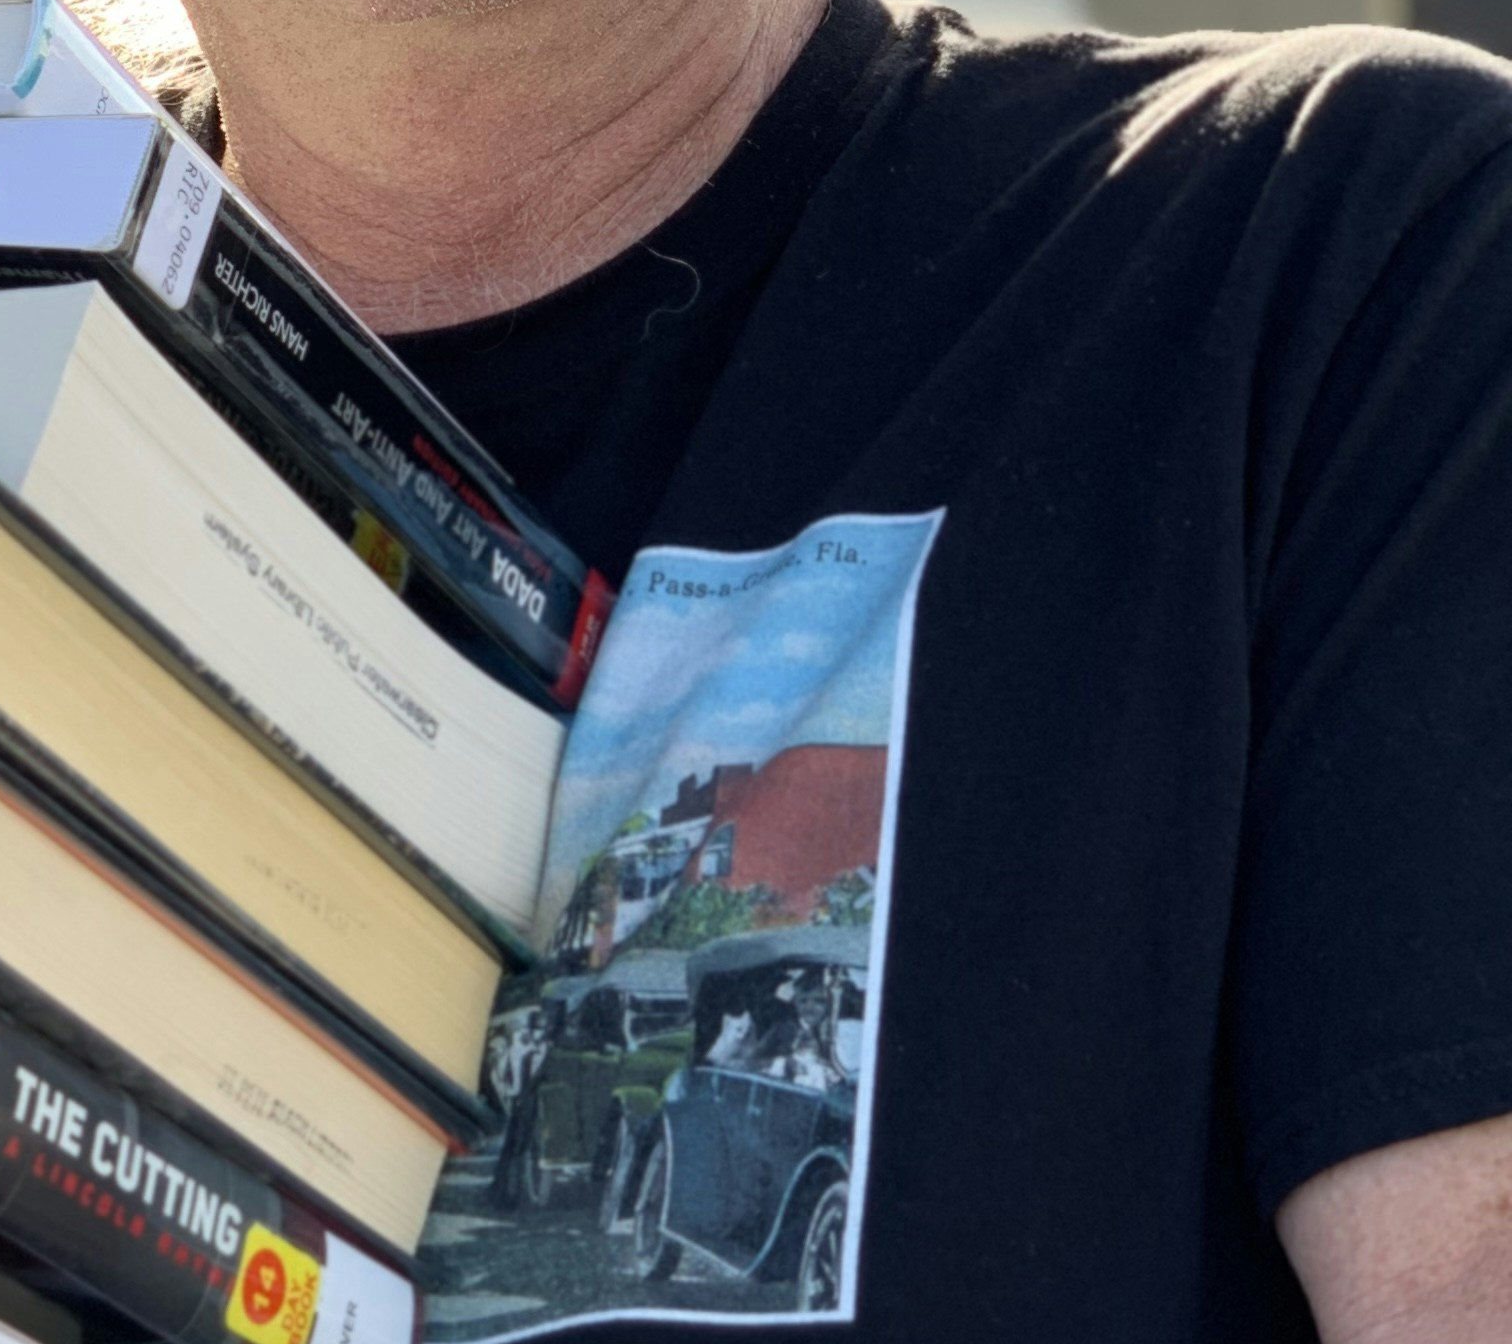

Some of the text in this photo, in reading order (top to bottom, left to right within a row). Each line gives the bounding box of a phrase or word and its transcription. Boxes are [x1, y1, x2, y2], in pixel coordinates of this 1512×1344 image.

[177, 162, 199, 206] RIC
[161, 171, 211, 296] 709.04062
[215, 252, 309, 361] HANS RICHTER
[491, 547, 547, 623] DADA
[815, 540, 868, 567] Fla.
[13, 1065, 88, 1159] THE
[91, 1120, 243, 1257] CUTTING
[252, 1264, 277, 1312] 14
[281, 1277, 302, 1333] DAY
